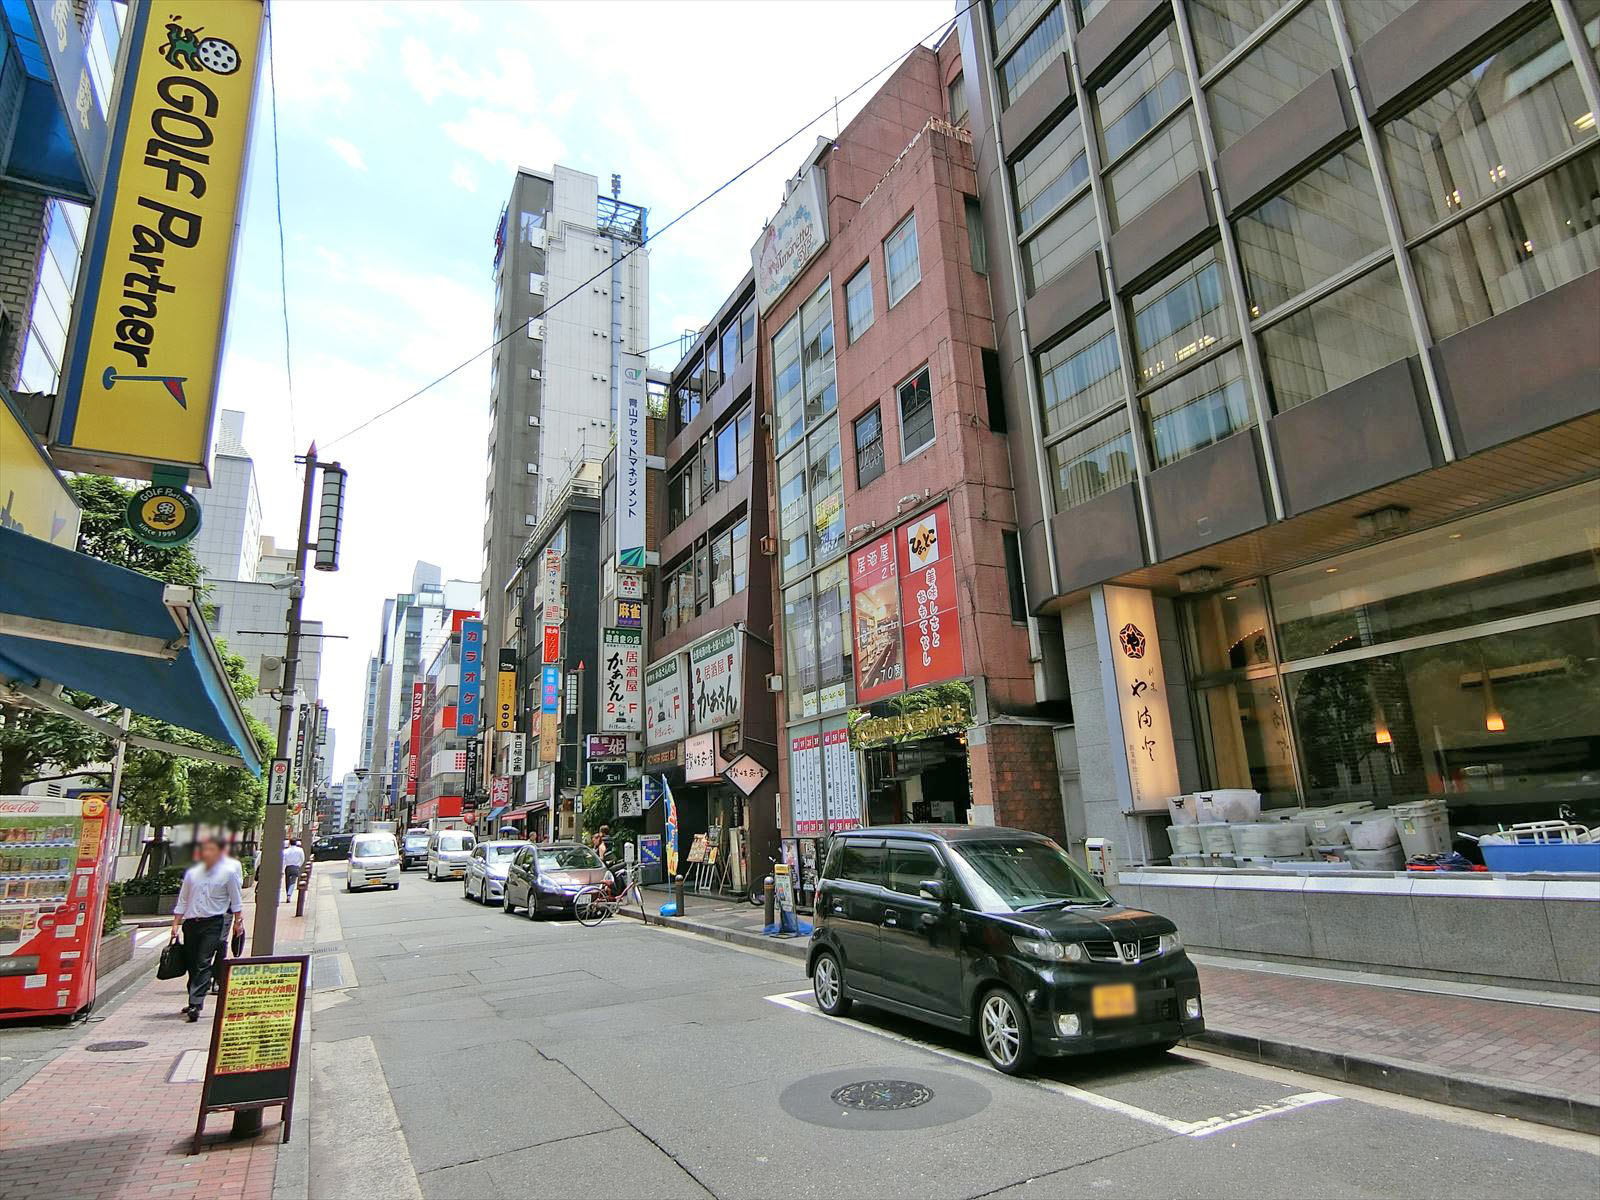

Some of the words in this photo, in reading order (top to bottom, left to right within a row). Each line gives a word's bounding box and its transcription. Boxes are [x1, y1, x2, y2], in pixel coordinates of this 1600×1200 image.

[144, 76, 219, 199] GOLF
[113, 194, 203, 368] Partner
[628, 398, 638, 518] 青山アセットマネジメント
[140, 488, 163, 501] GOLF
[165, 488, 190, 508] Partner
[909, 528, 937, 556] ひょっとこ
[856, 543, 888, 575] 居酒屋
[881, 562, 896, 579] 2F
[619, 602, 641, 619] 麻雀
[926, 567, 940, 648] 美味しさと
[917, 589, 931, 667] おもてなし
[462, 631, 478, 726] カラオケ館
[626, 650, 638, 692] 居酒屋
[704, 658, 725, 680] 居酒屋
[412, 692, 422, 720] カラオケ
[607, 702, 615, 713] 2
[629, 703, 638, 713] F
[604, 738, 626, 755] 姫
[493, 778, 509, 802] 焼肉
[232, 966, 260, 976] GOLF
